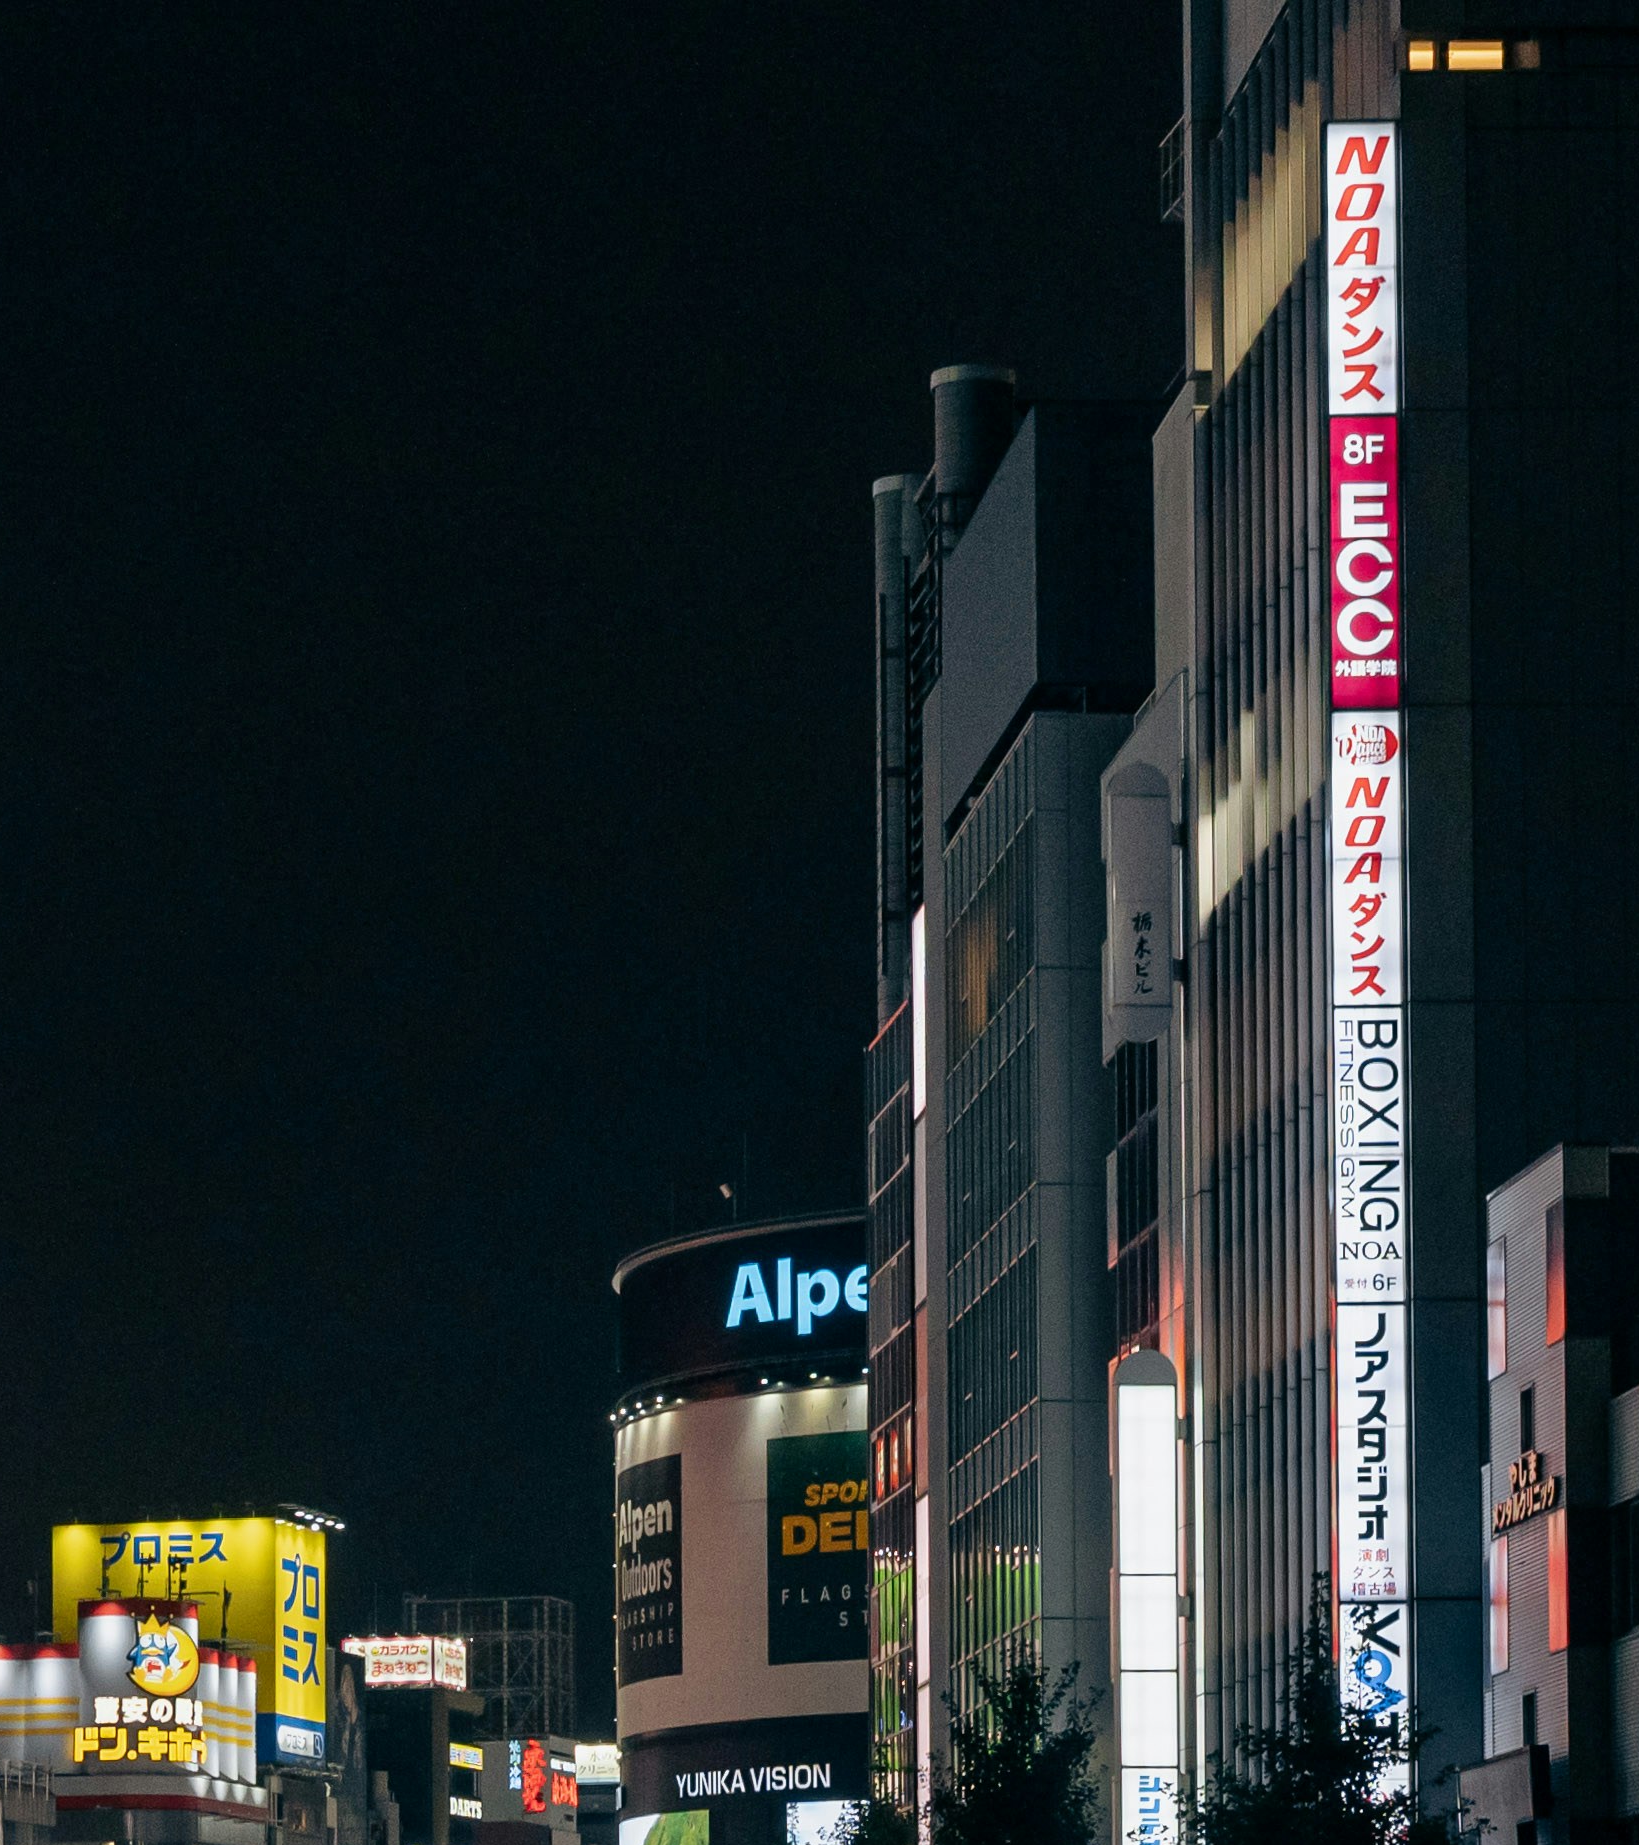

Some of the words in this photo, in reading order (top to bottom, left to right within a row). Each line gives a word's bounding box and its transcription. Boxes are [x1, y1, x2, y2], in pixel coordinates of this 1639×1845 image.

[1333, 135, 1390, 267] NOA
[1338, 275, 1385, 402] ダンス
[1342, 433, 1385, 466] 8F
[1336, 482, 1396, 656] ECC
[1334, 658, 1398, 677] 外語学院
[1343, 775, 1390, 884] NOA
[1347, 892, 1387, 997] ダンス
[1338, 1019, 1355, 1149] FITNESS
[1357, 1018, 1401, 1233] BOXING
[1338, 1156, 1355, 1219] GYM
[1339, 1240, 1402, 1261] NOA
[1372, 1273, 1397, 1292] 6F
[1353, 1312, 1389, 1541] ノアスタジオ
[99, 1531, 228, 1568] プロミス
[618, 1499, 673, 1554] Alpen
[1351, 1565, 1395, 1579] ダンス
[449, 1796, 483, 1820] DARTS
[675, 1769, 746, 1799] YUNIKA
[749, 1763, 831, 1793] VISION
